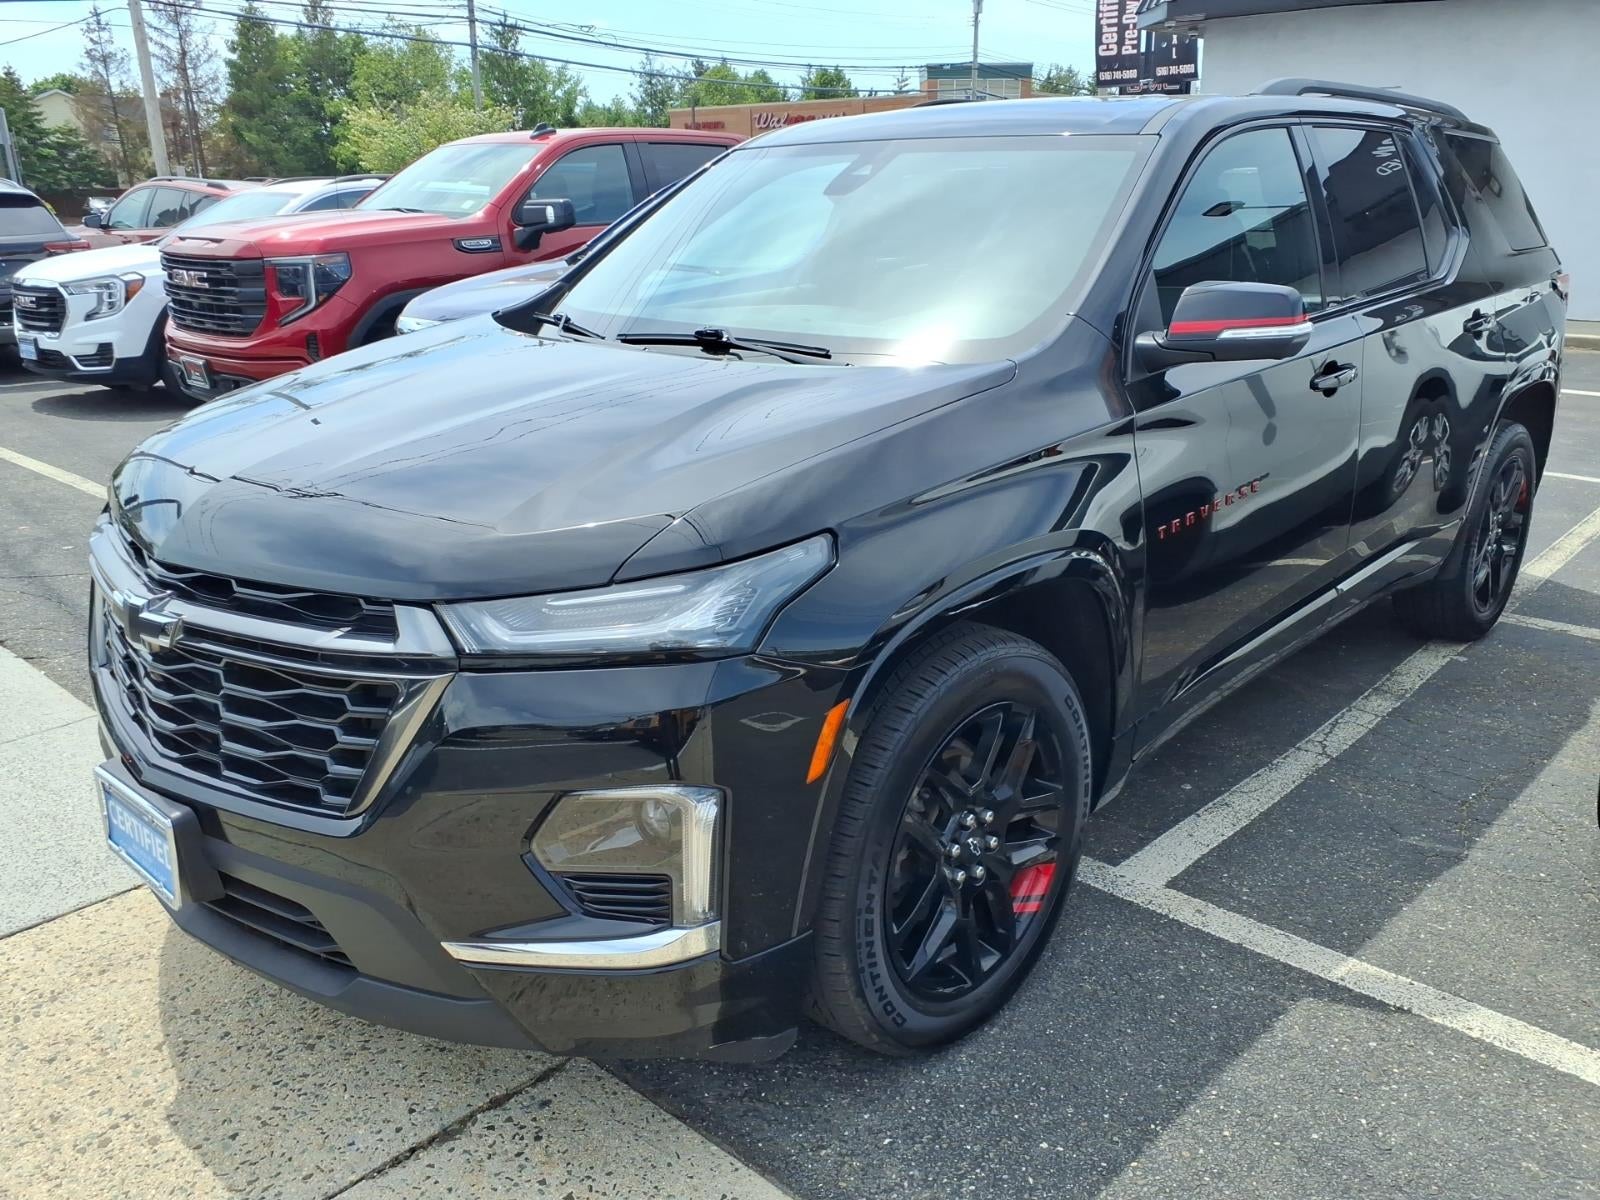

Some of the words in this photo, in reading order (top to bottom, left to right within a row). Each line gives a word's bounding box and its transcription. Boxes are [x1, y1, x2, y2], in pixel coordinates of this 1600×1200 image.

[1099, 71, 1112, 80] (516)
[1156, 66, 1169, 76] (516)
[172, 269, 209, 288] GMC
[1158, 481, 1260, 539] TRAVERSE
[864, 842, 907, 1027] CONTINENTA
